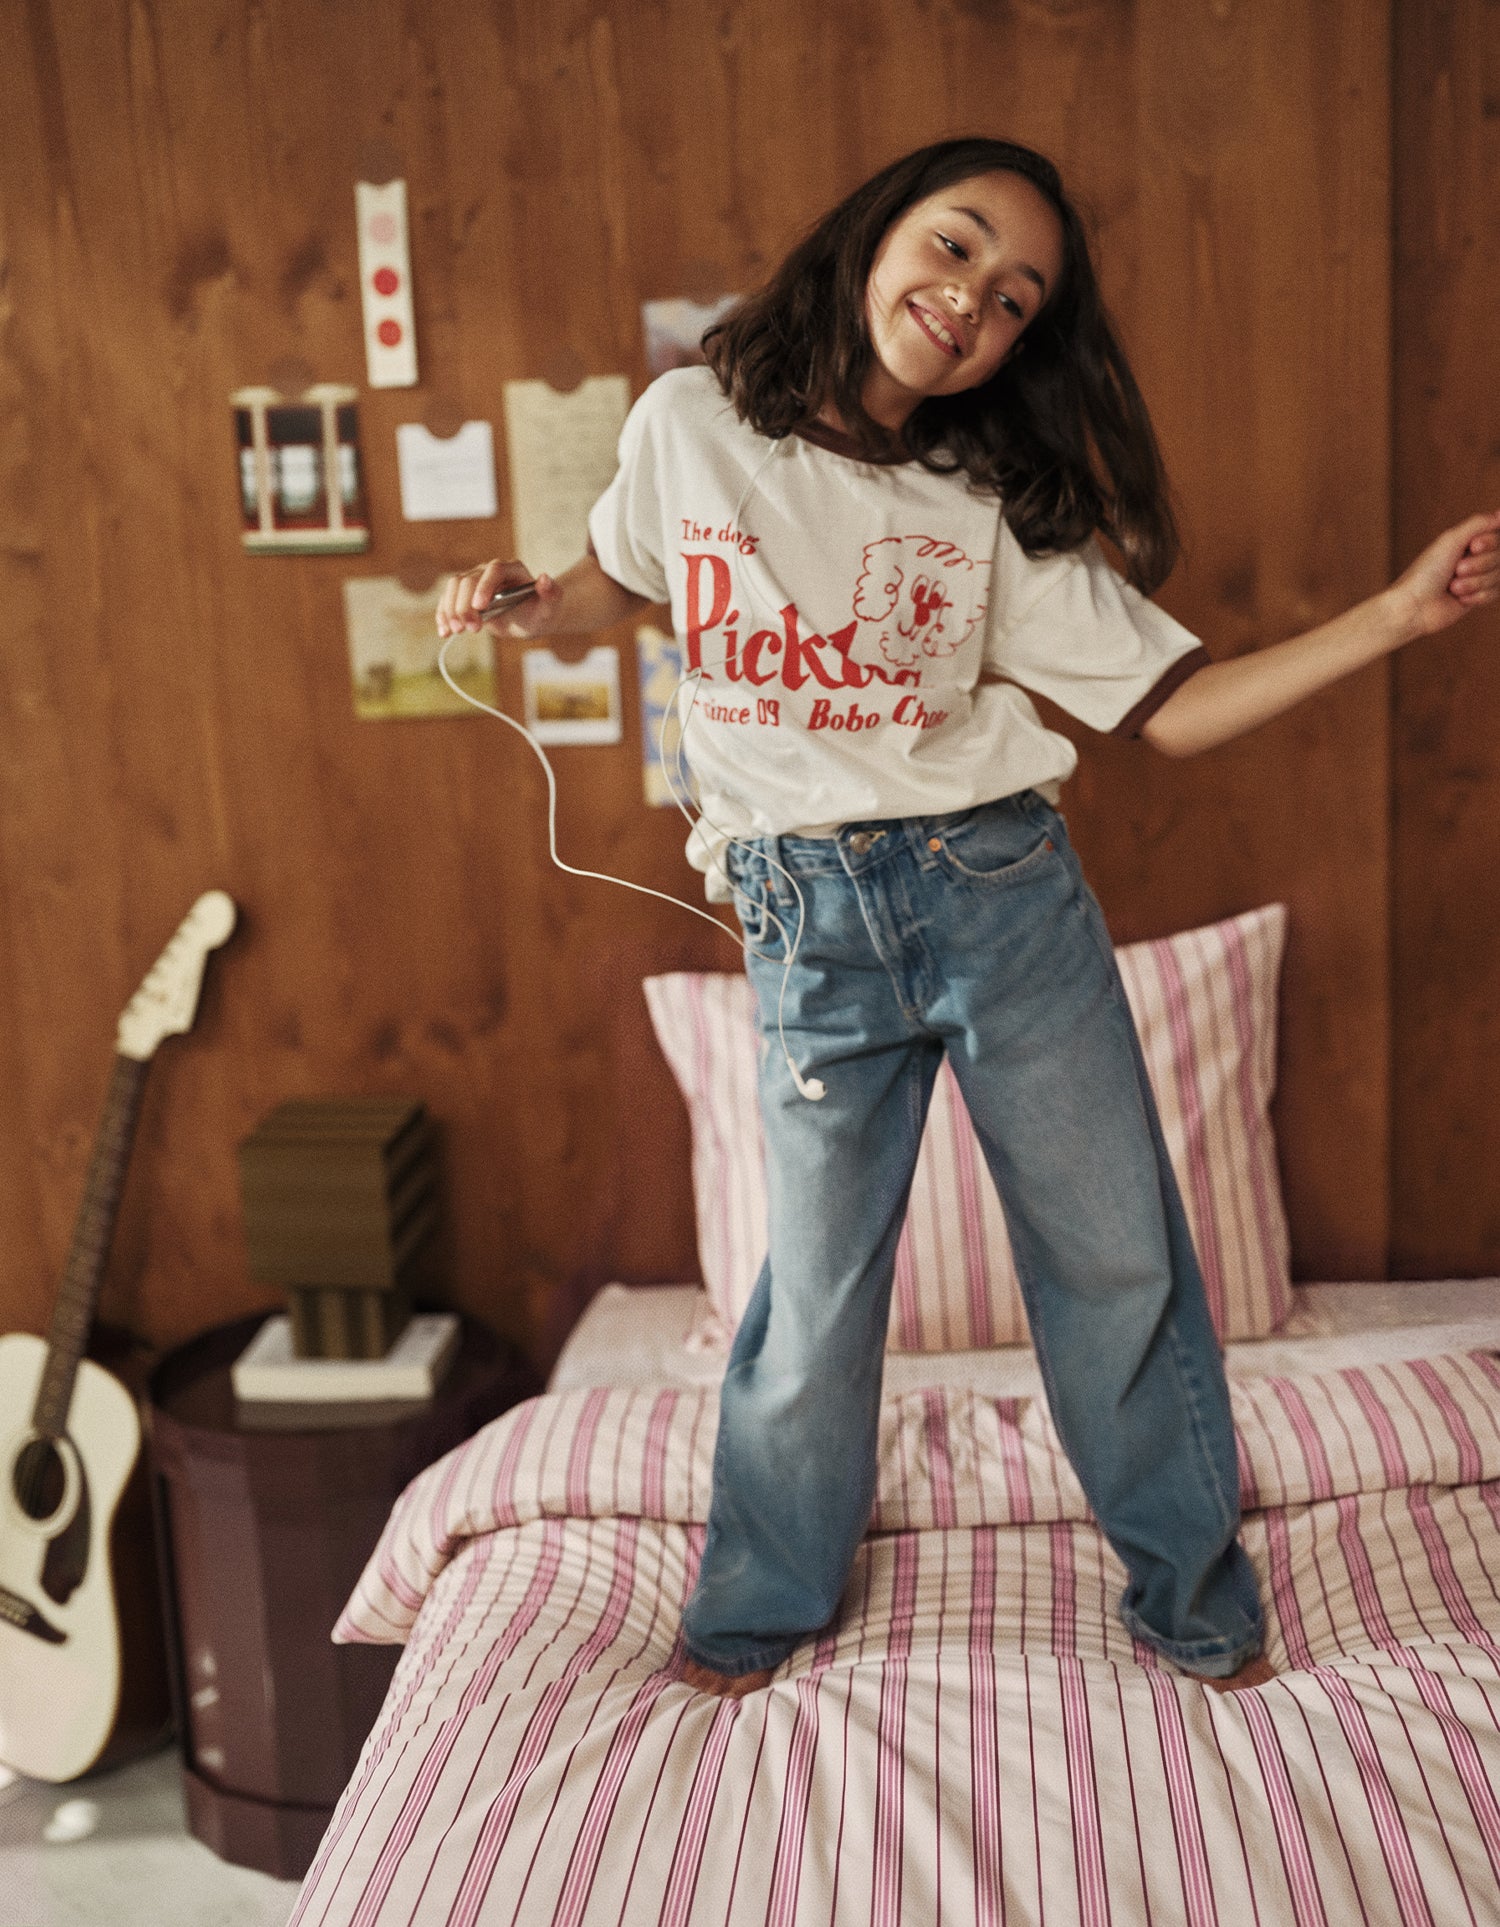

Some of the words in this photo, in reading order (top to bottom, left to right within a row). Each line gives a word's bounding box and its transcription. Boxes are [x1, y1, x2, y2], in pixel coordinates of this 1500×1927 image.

[681, 519, 713, 541] The
[718, 520, 760, 555] dog
[757, 698, 781, 728] 09
[807, 698, 881, 732] Bobo
